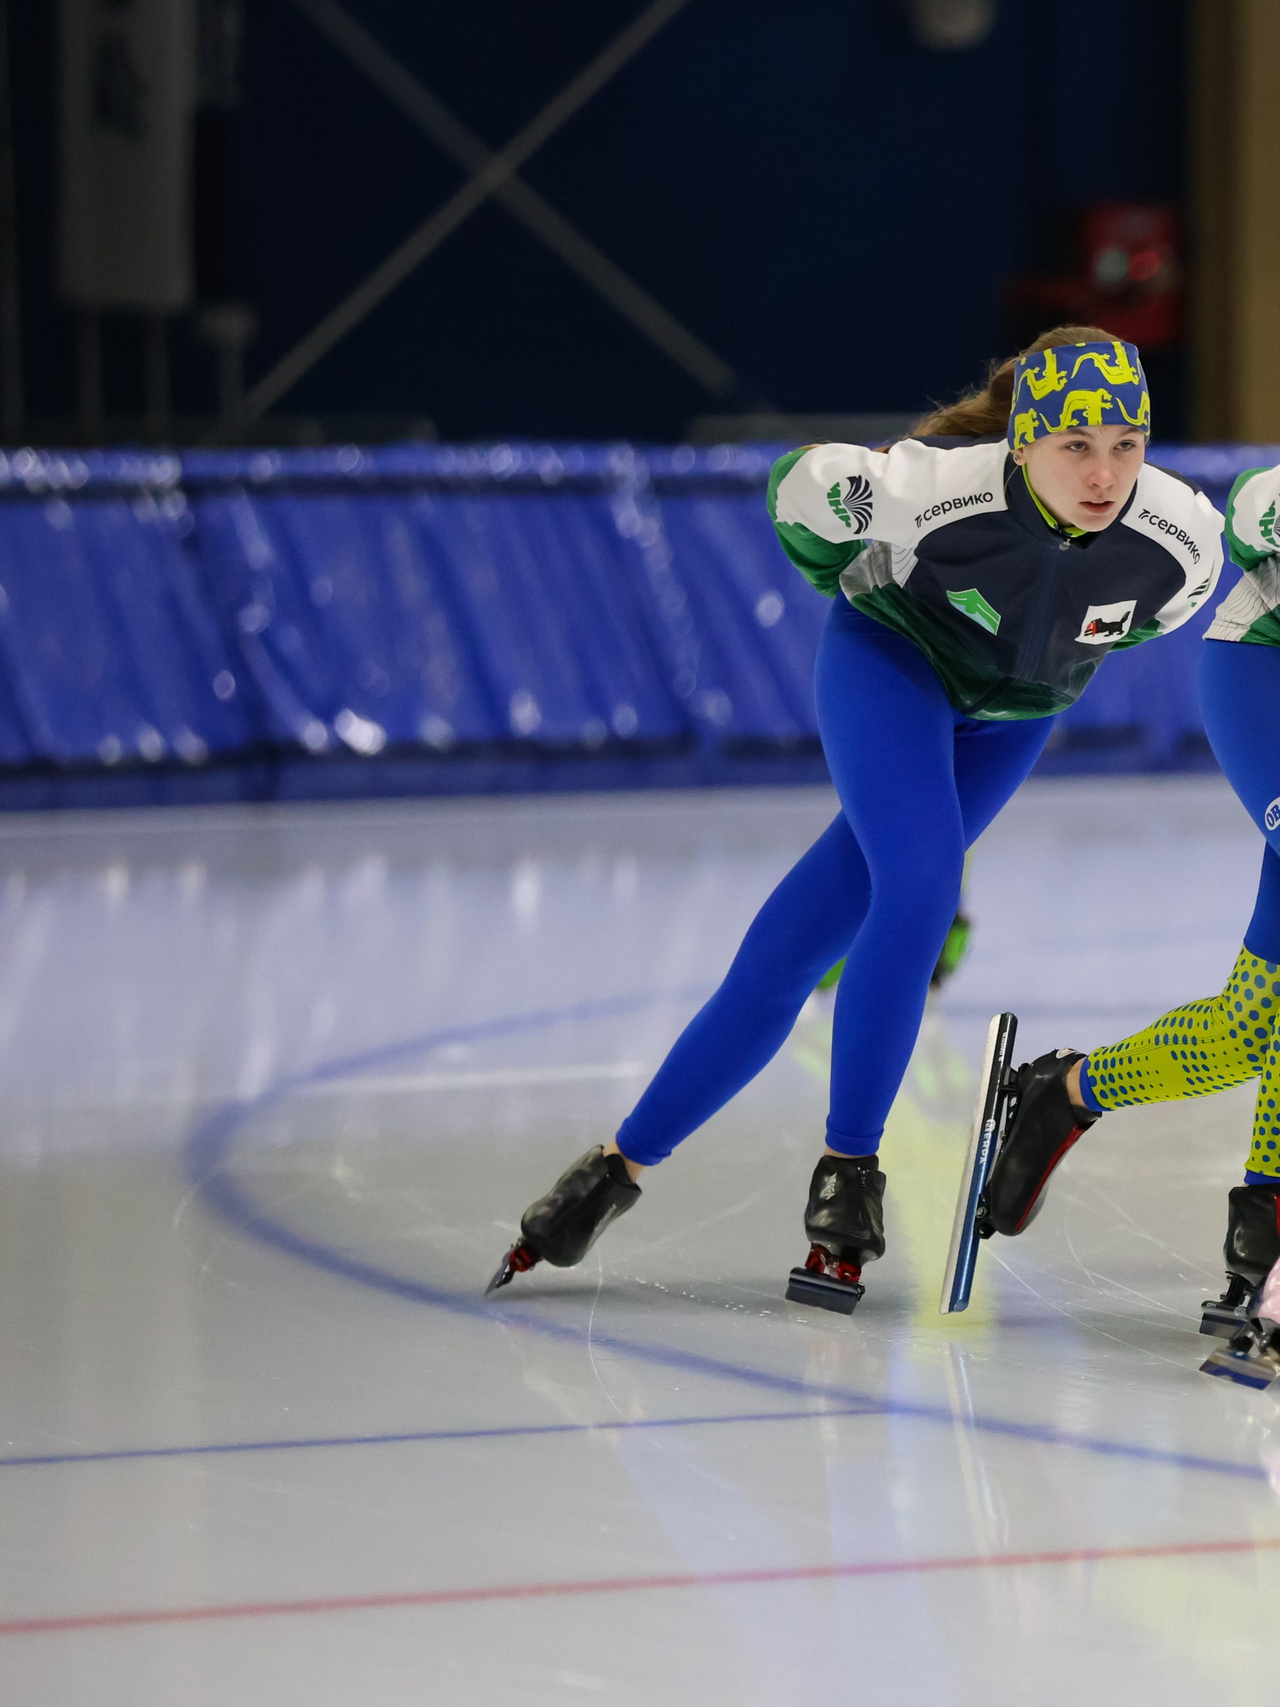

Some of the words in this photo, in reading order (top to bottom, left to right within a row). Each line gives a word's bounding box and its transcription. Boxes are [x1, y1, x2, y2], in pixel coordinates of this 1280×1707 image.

[826, 481, 852, 528] ИНК
[923, 491, 994, 522] сервико
[1148, 514, 1201, 566] сервико
